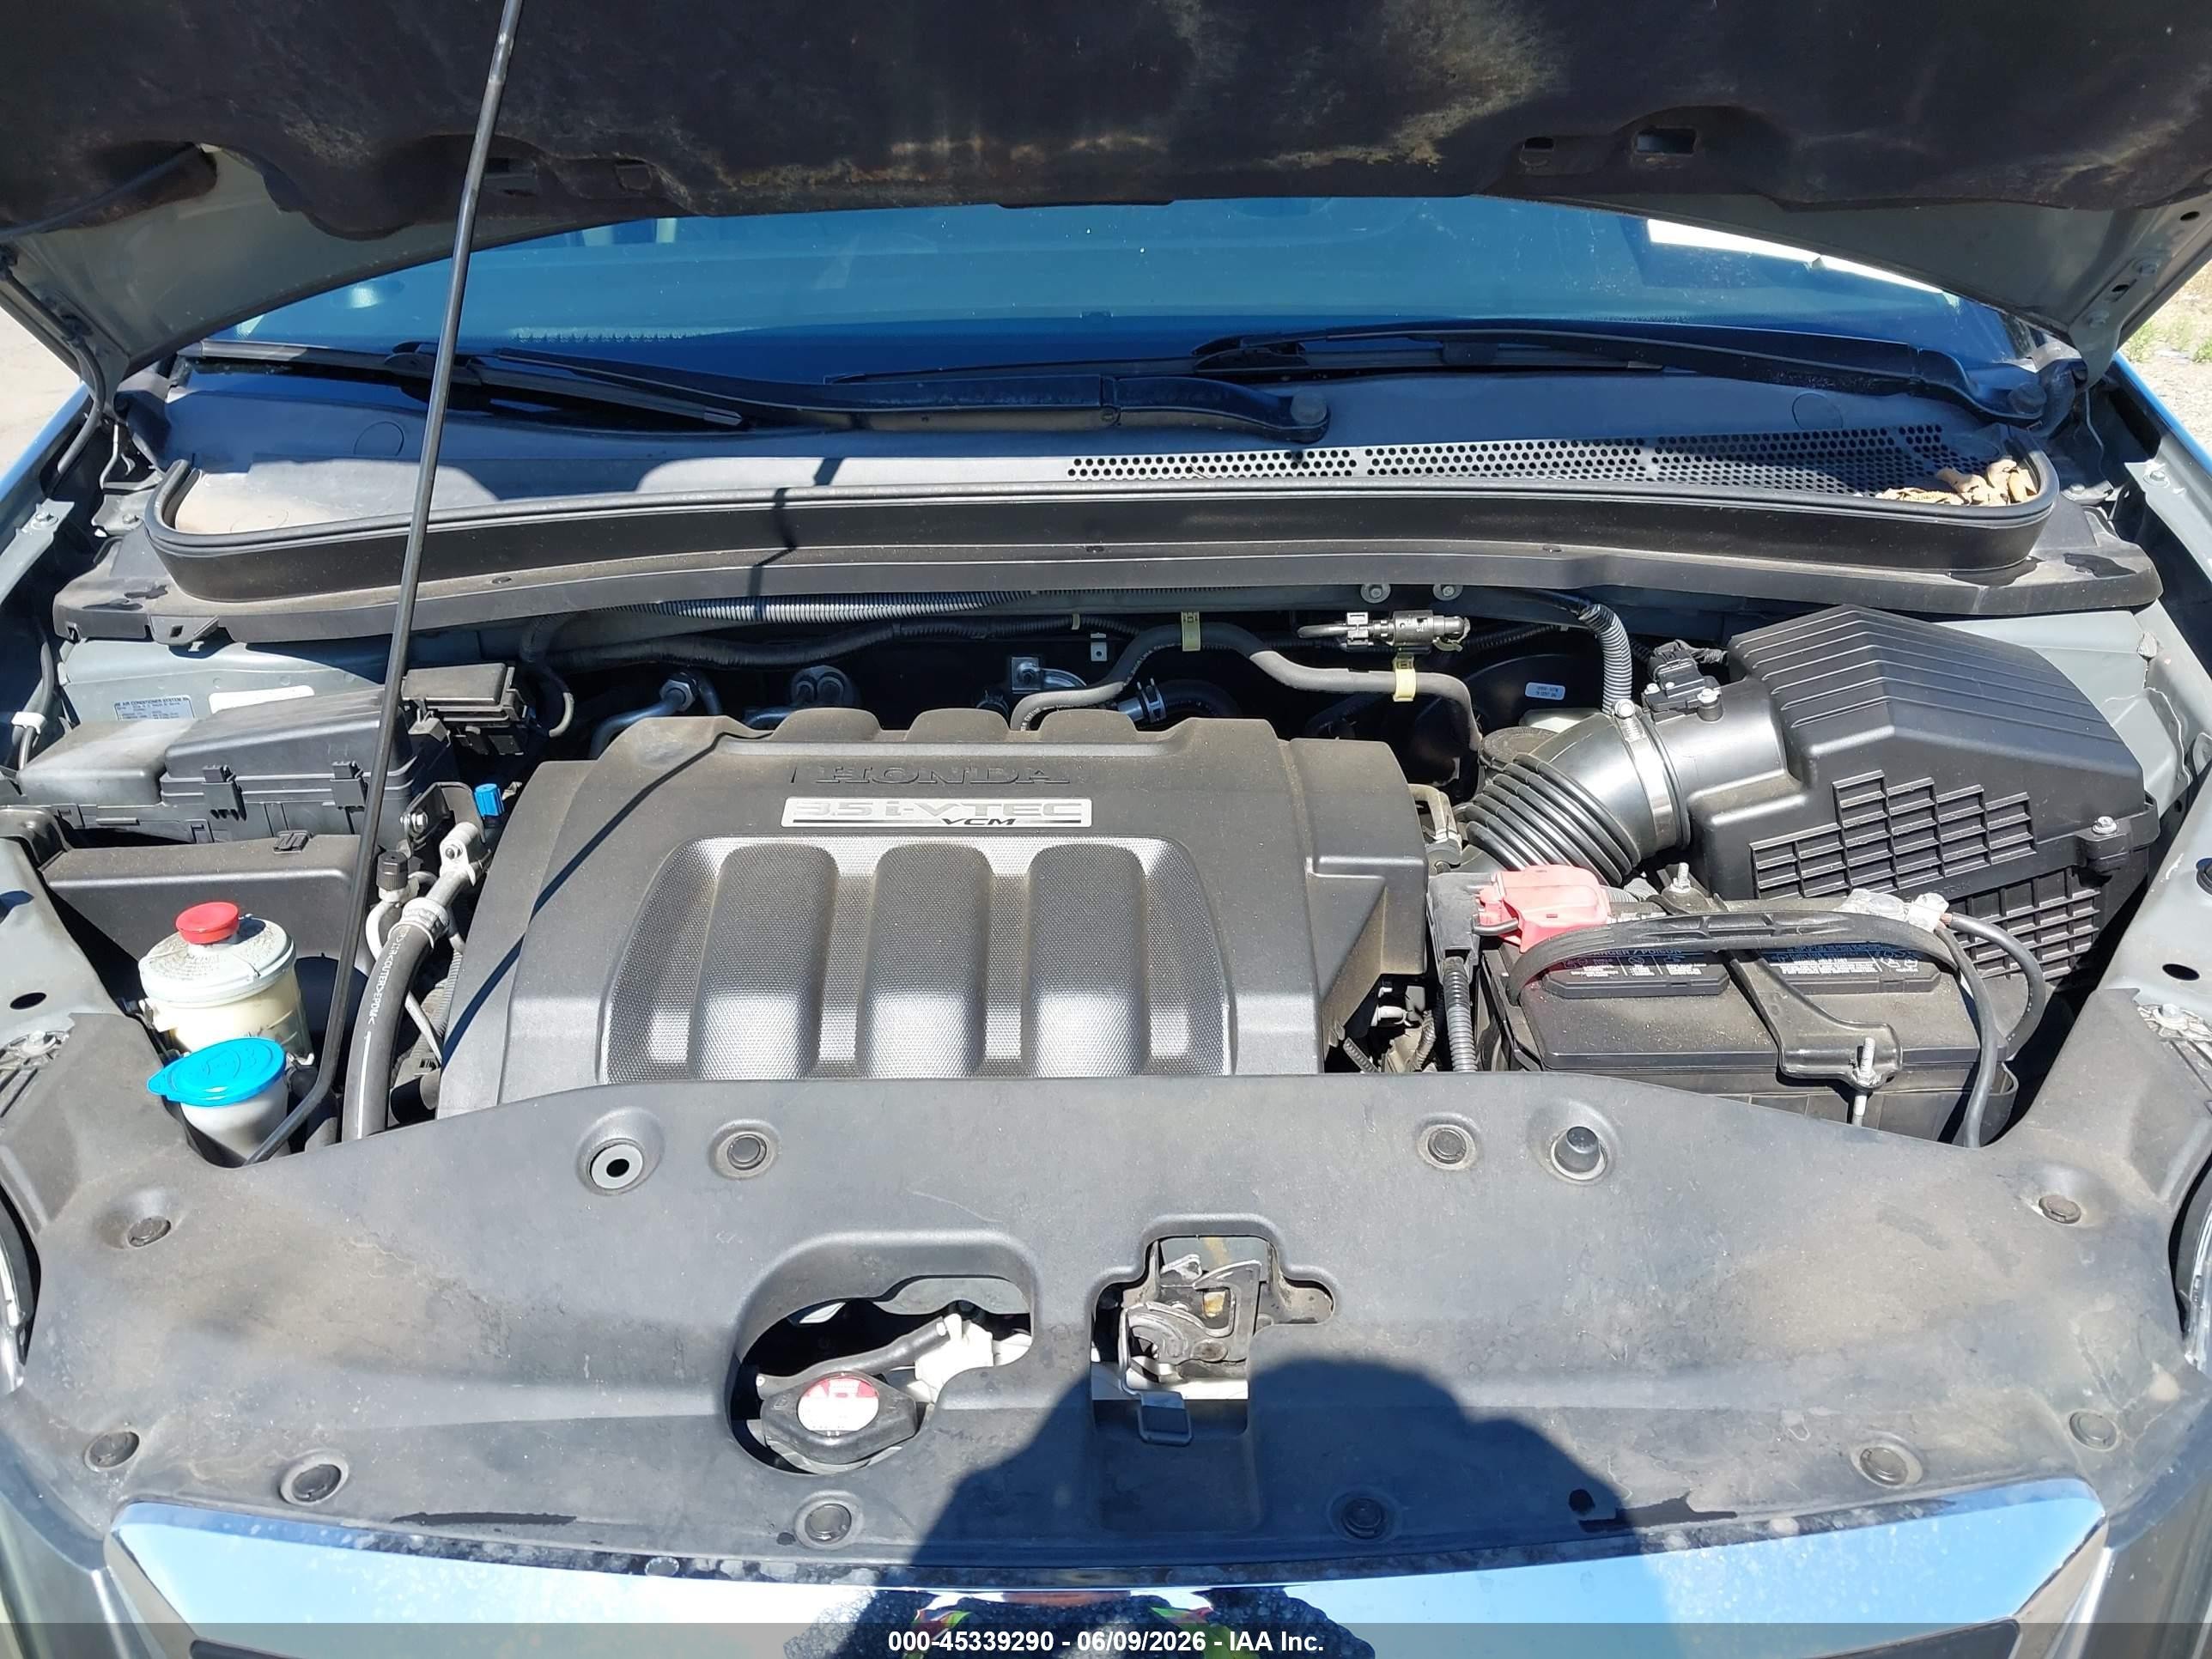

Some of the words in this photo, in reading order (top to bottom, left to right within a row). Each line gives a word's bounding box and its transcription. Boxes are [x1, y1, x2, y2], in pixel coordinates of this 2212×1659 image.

[815, 765, 1071, 785] HONDA
[793, 800, 874, 817] 3.5
[884, 799, 1083, 817] i-VTEC
[941, 817, 1017, 826] VCM
